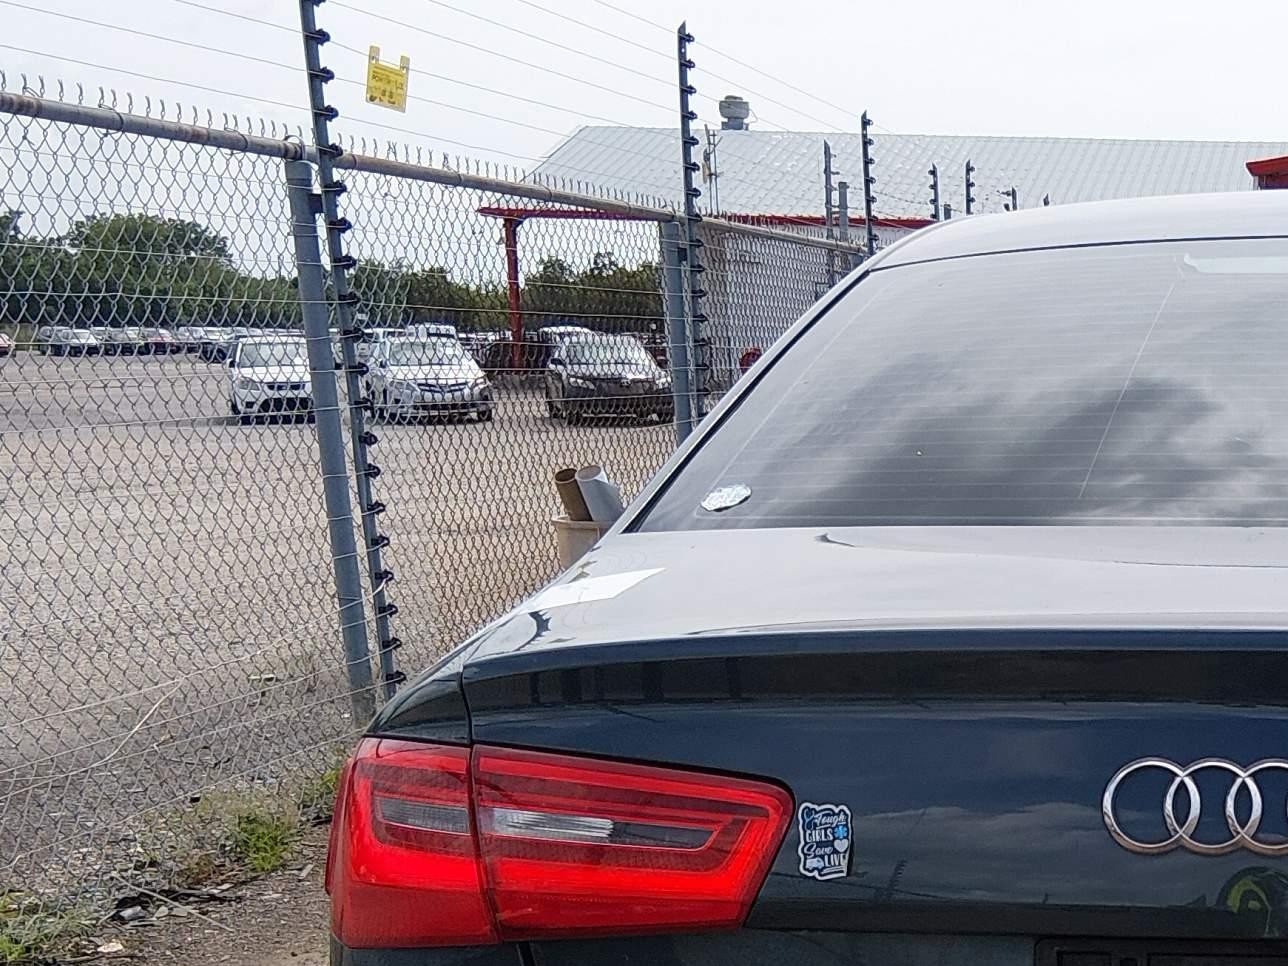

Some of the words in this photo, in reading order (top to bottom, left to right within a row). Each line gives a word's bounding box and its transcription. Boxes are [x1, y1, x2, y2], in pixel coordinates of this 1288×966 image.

[814, 810, 847, 827] Tough
[806, 829, 833, 842] GIRLS
[804, 843, 833, 858] Save
